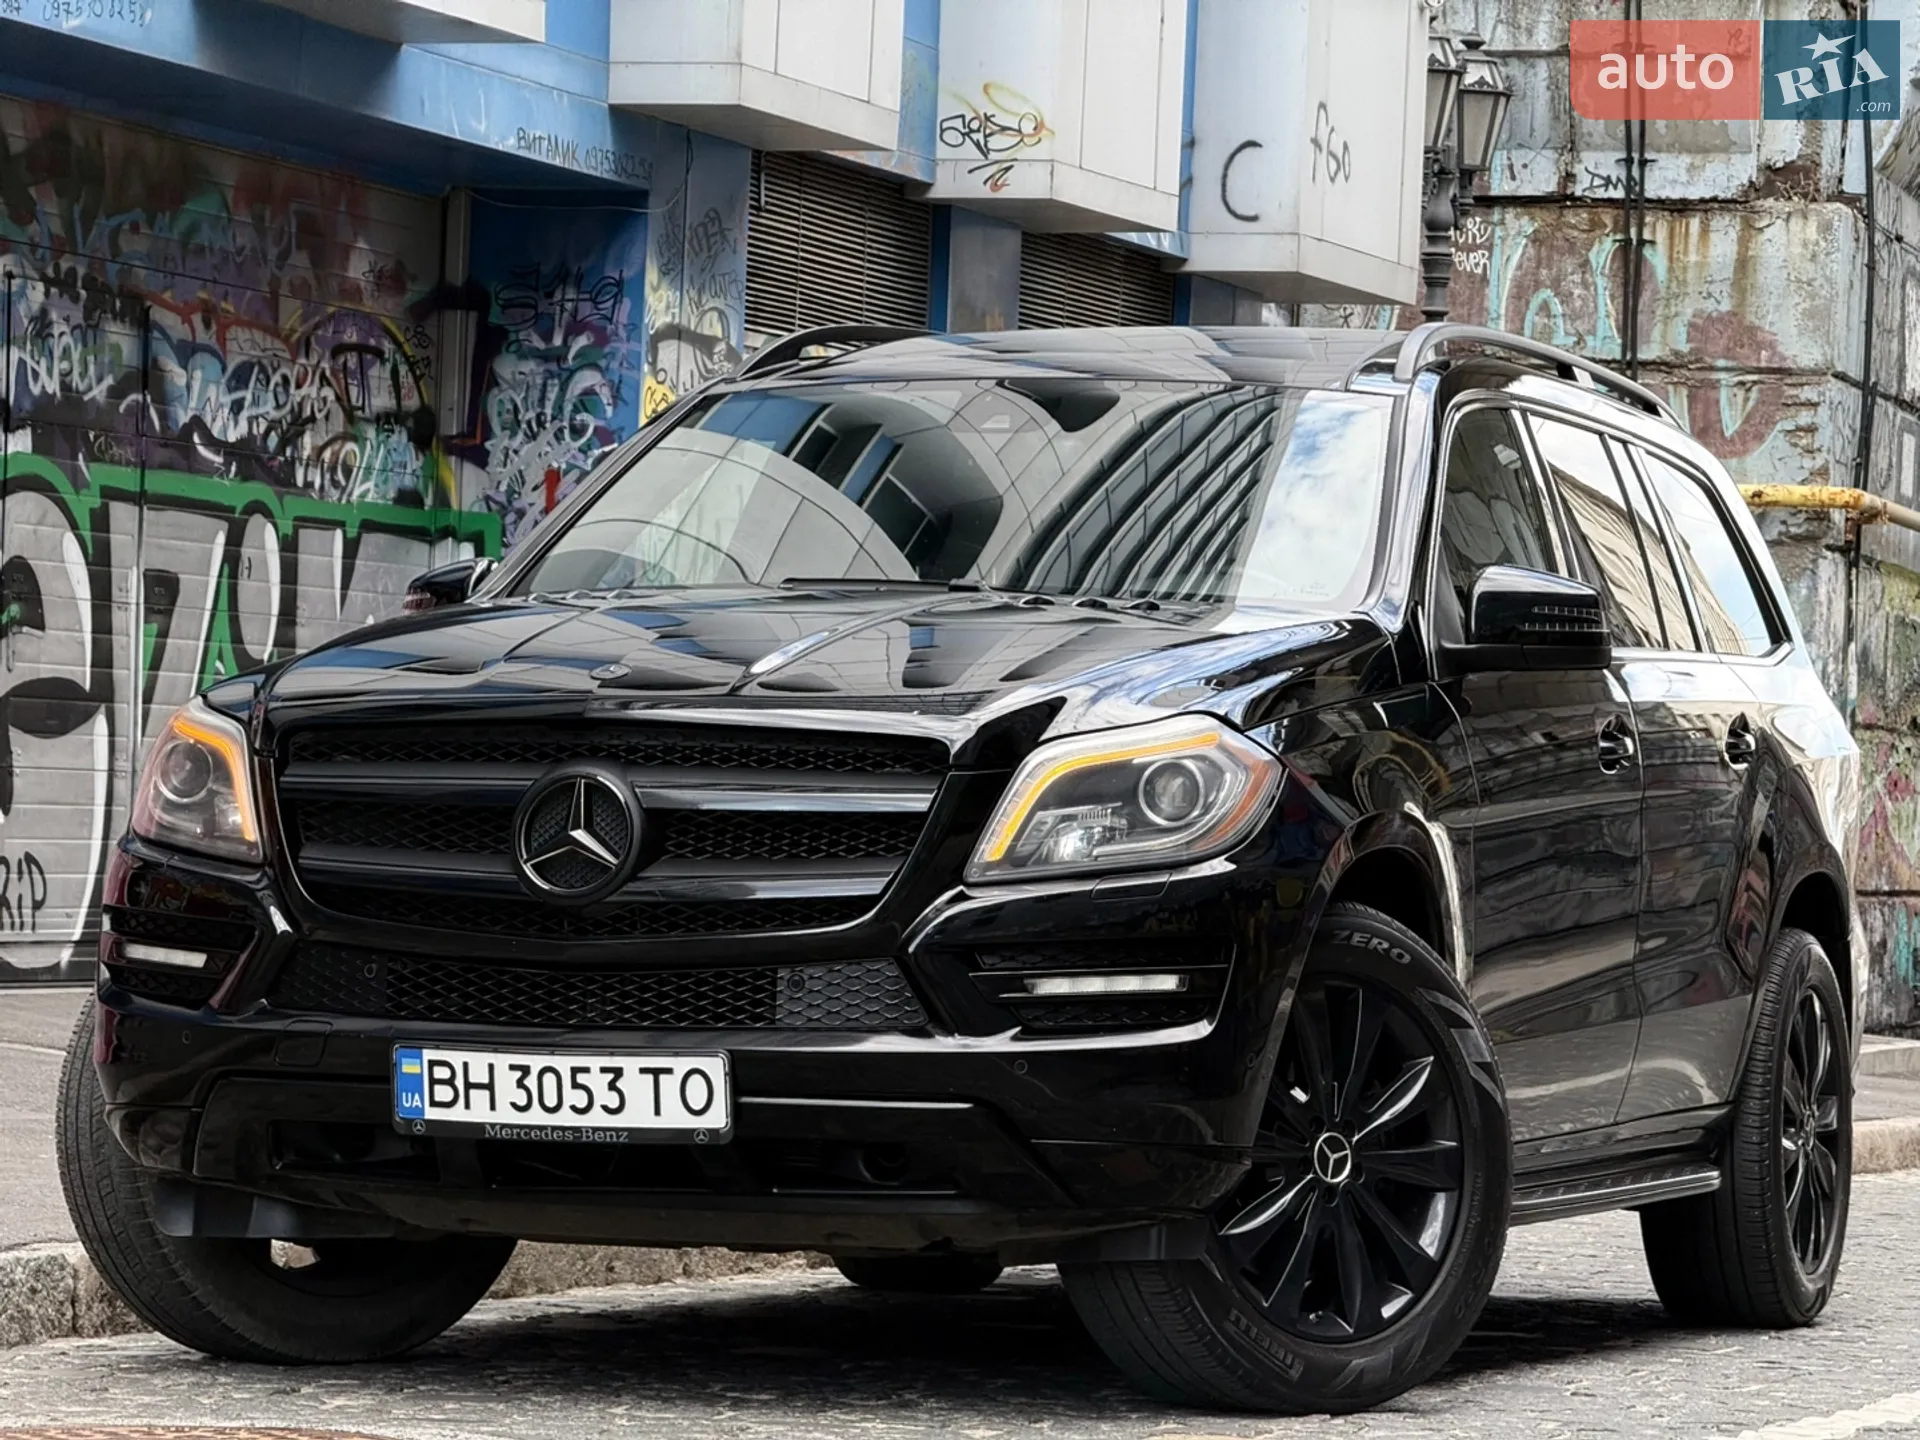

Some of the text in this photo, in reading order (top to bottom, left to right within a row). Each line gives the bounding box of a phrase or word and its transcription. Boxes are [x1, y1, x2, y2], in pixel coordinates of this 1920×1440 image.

[1331, 929, 1412, 964] ZERO
[402, 1093, 422, 1109] UA
[428, 1059, 715, 1117] BH 3053 TO
[484, 1123, 629, 1142] Mercedes-Benz
